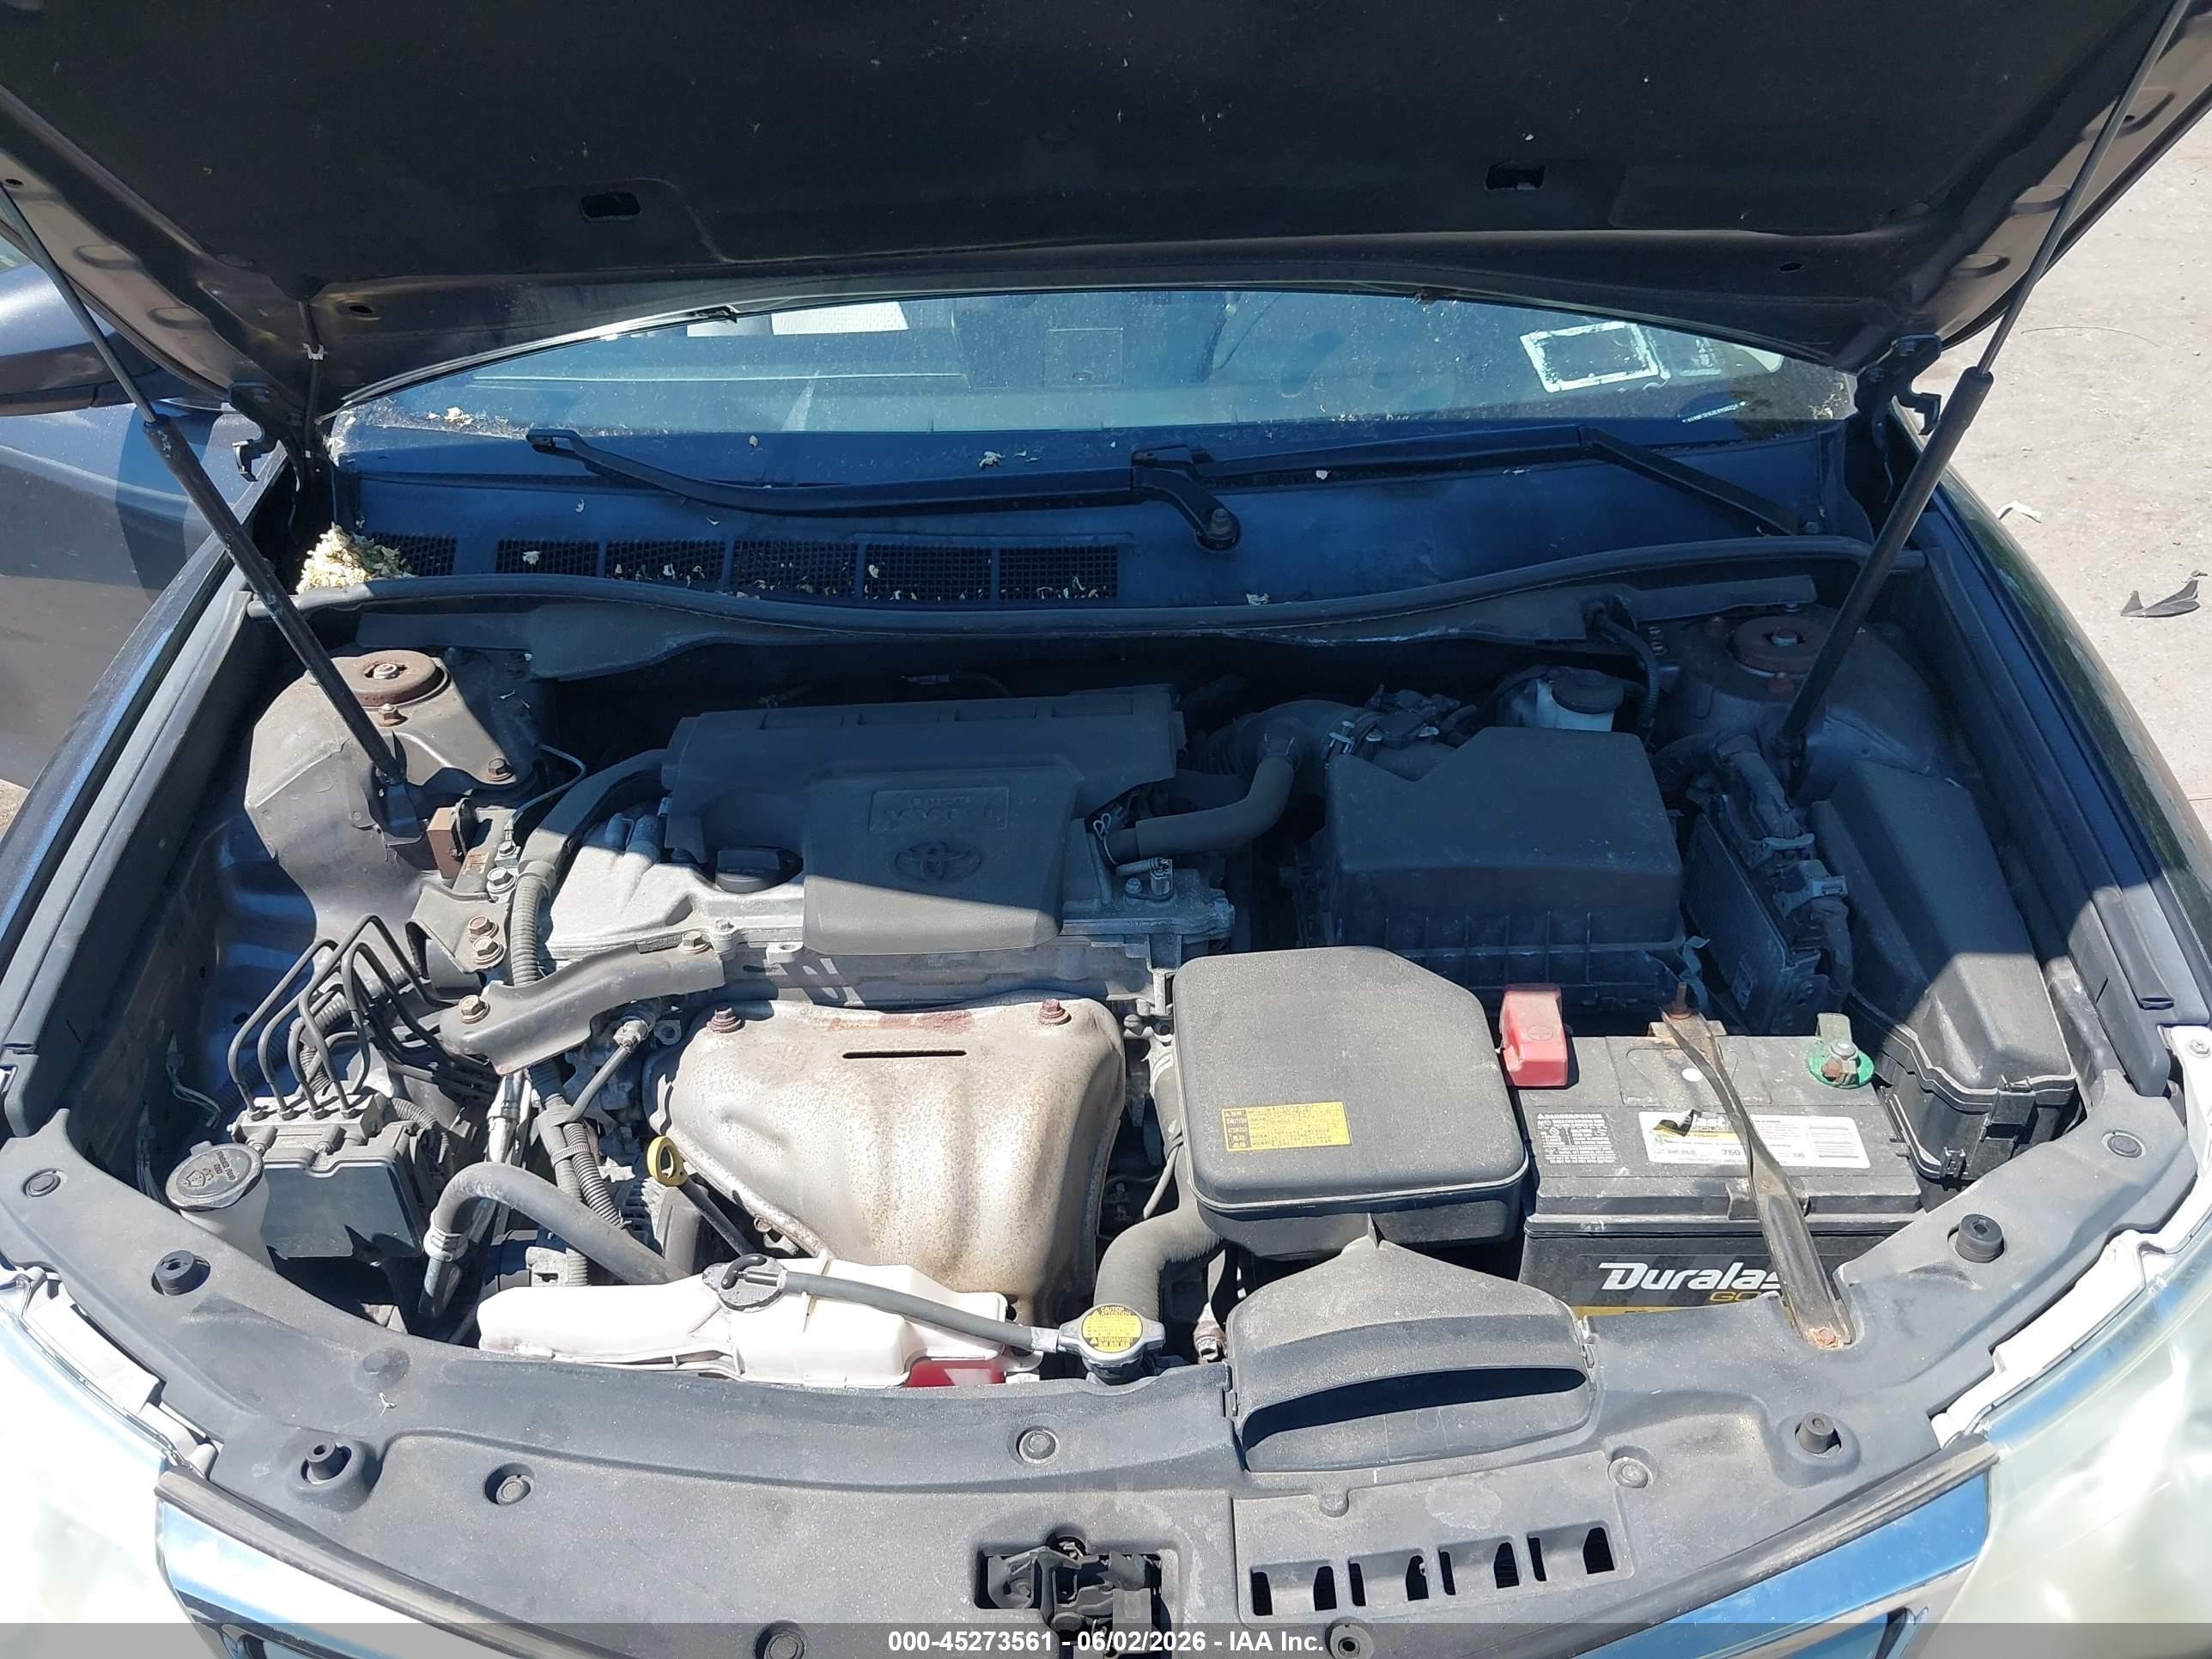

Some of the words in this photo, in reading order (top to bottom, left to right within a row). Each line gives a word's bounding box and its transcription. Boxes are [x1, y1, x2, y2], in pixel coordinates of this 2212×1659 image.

[1691, 1114, 1726, 1128] last
[1598, 1262, 1783, 1291] Duralas
[1710, 1291, 1760, 1302] GO
